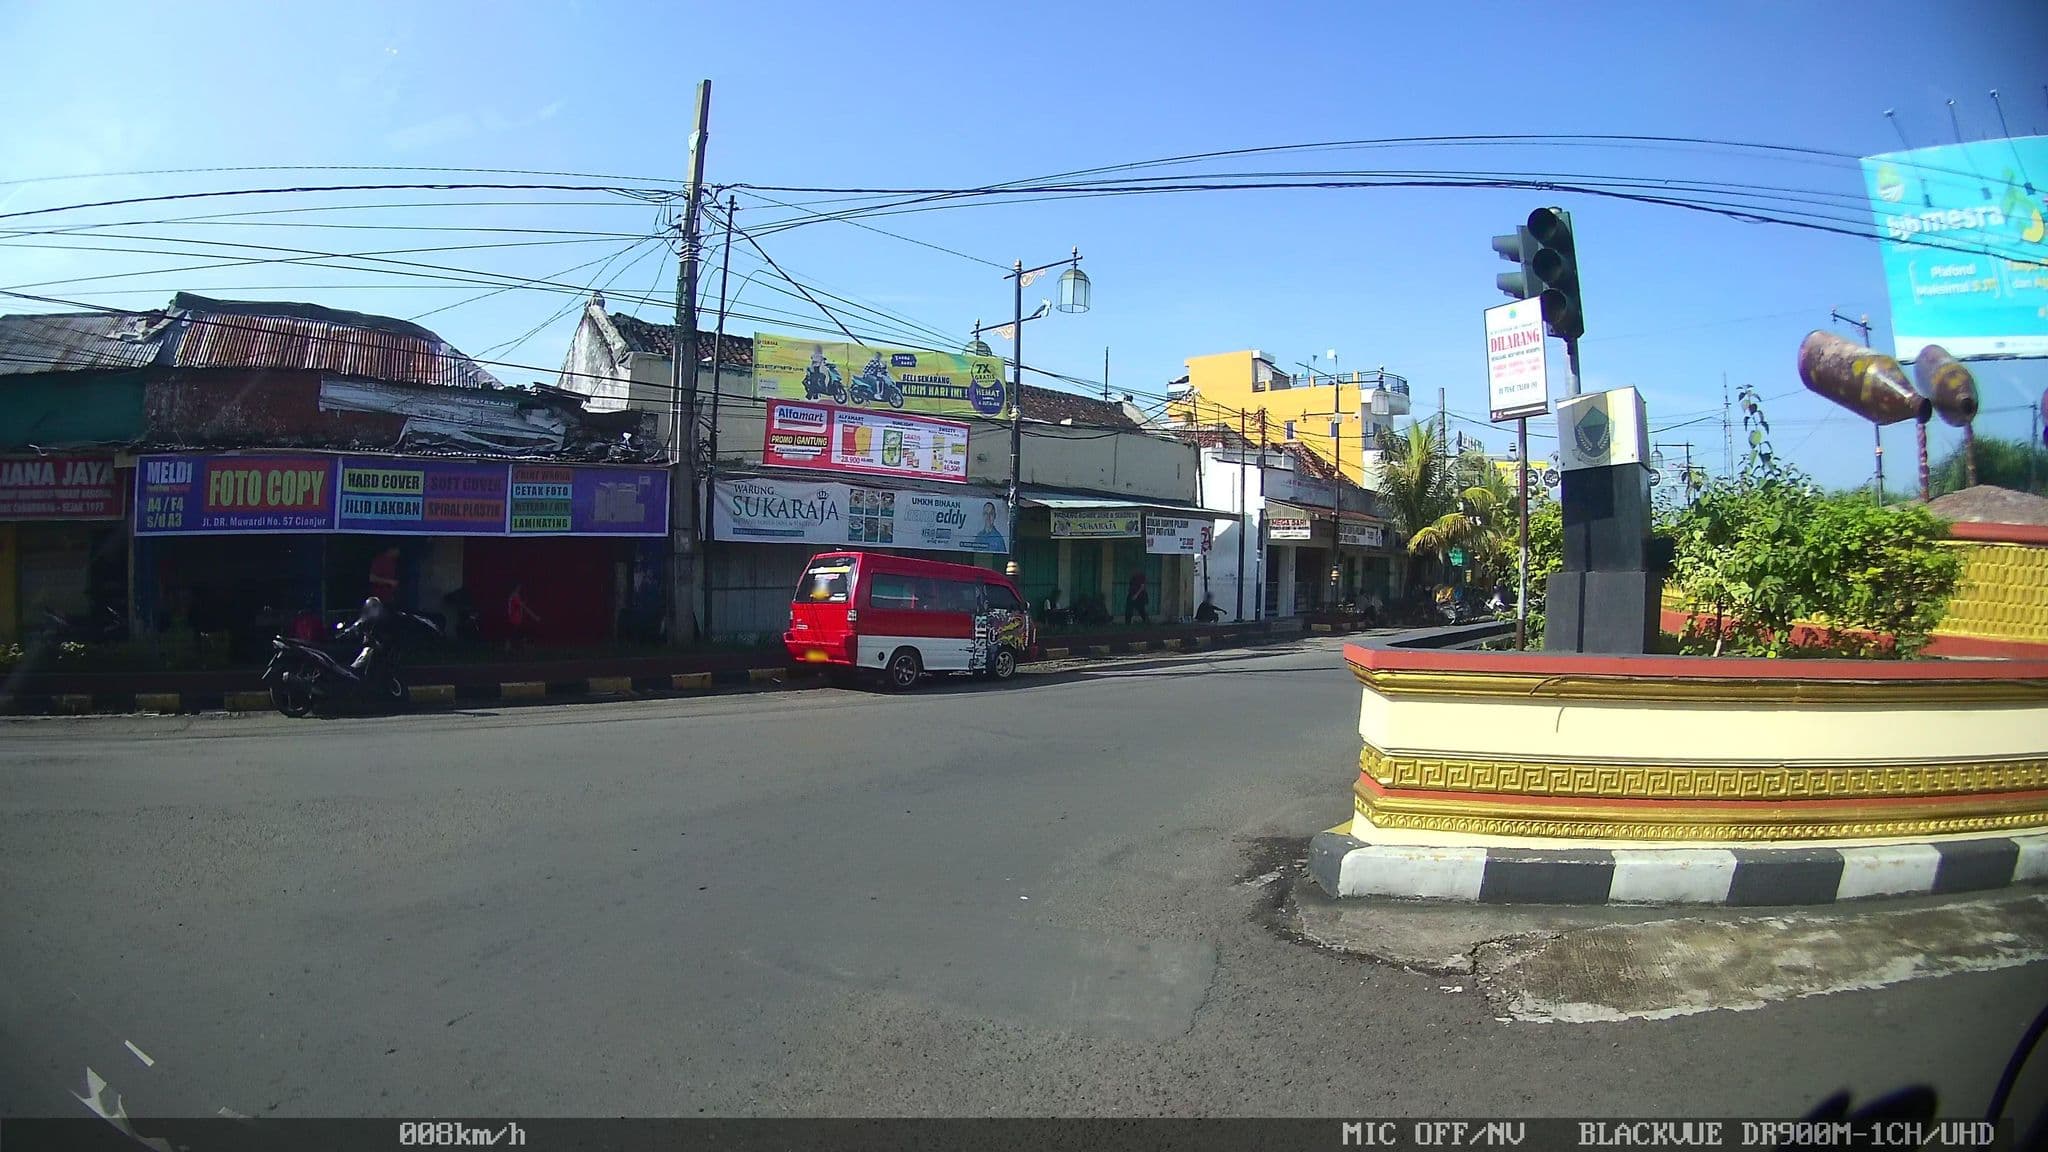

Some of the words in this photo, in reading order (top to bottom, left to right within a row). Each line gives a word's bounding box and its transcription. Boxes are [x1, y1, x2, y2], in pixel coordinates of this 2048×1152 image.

[1490, 328, 1540, 353] DILARANG
[975, 364, 991, 374] 7X
[902, 384, 926, 396] KIRIM
[928, 386, 948, 397] HARI
[950, 388, 963, 398] INI
[976, 388, 1000, 397] HEMAT
[778, 407, 825, 422] Alfamart
[771, 434, 794, 444] PROMO
[796, 435, 828, 446] GANTUNG
[61, 461, 114, 486] JAYA
[147, 461, 193, 484] MELDI
[208, 470, 262, 507] FOTO
[266, 470, 325, 507] COPY
[348, 472, 379, 488] HARD
[382, 474, 420, 490] COVER
[515, 486, 543, 496] CETAK
[545, 486, 568, 496] FOTO
[734, 484, 775, 496] WARUNG
[147, 497, 161, 512] A4
[171, 496, 184, 512] F4
[345, 499, 372, 514] JILID
[429, 501, 461, 516] SPIRAL
[732, 495, 839, 526] SUKARAJA
[911, 497, 934, 506] UMKM
[934, 499, 961, 509] BINAAN
[282, 516, 293, 526] 57
[295, 515, 327, 528] Cianjur
[514, 518, 568, 529] LAMINATING
